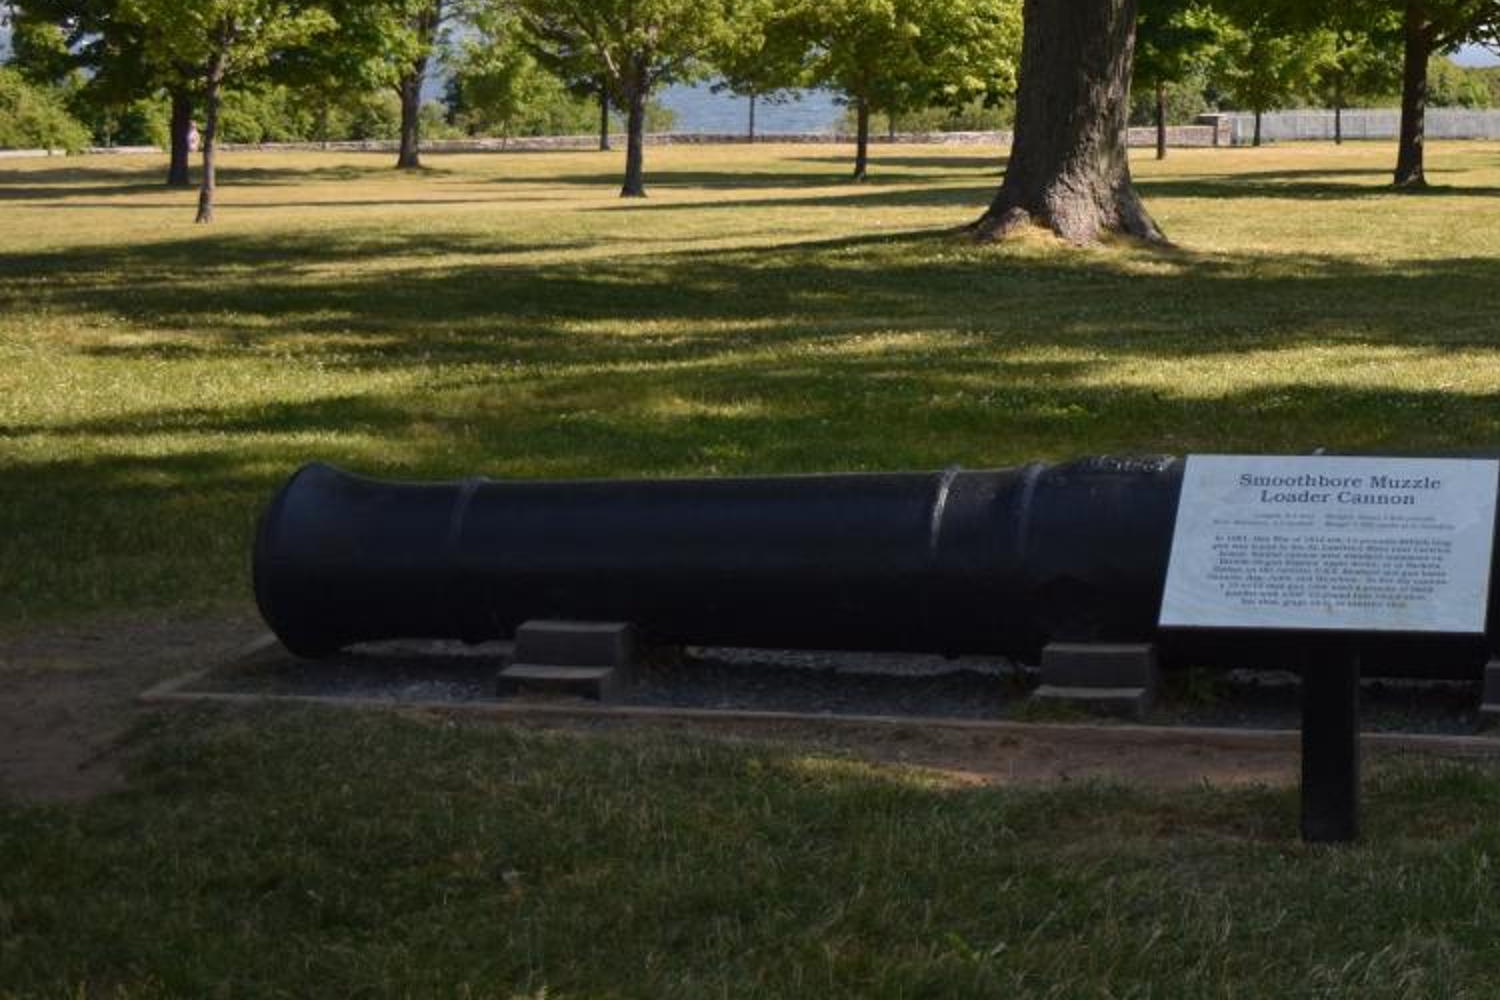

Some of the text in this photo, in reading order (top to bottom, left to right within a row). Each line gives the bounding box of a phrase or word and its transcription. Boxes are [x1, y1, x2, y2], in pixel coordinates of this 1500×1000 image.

[1239, 473, 1441, 489] Smoothbore Muzzle
[1260, 490, 1416, 505] Loader Cannon
